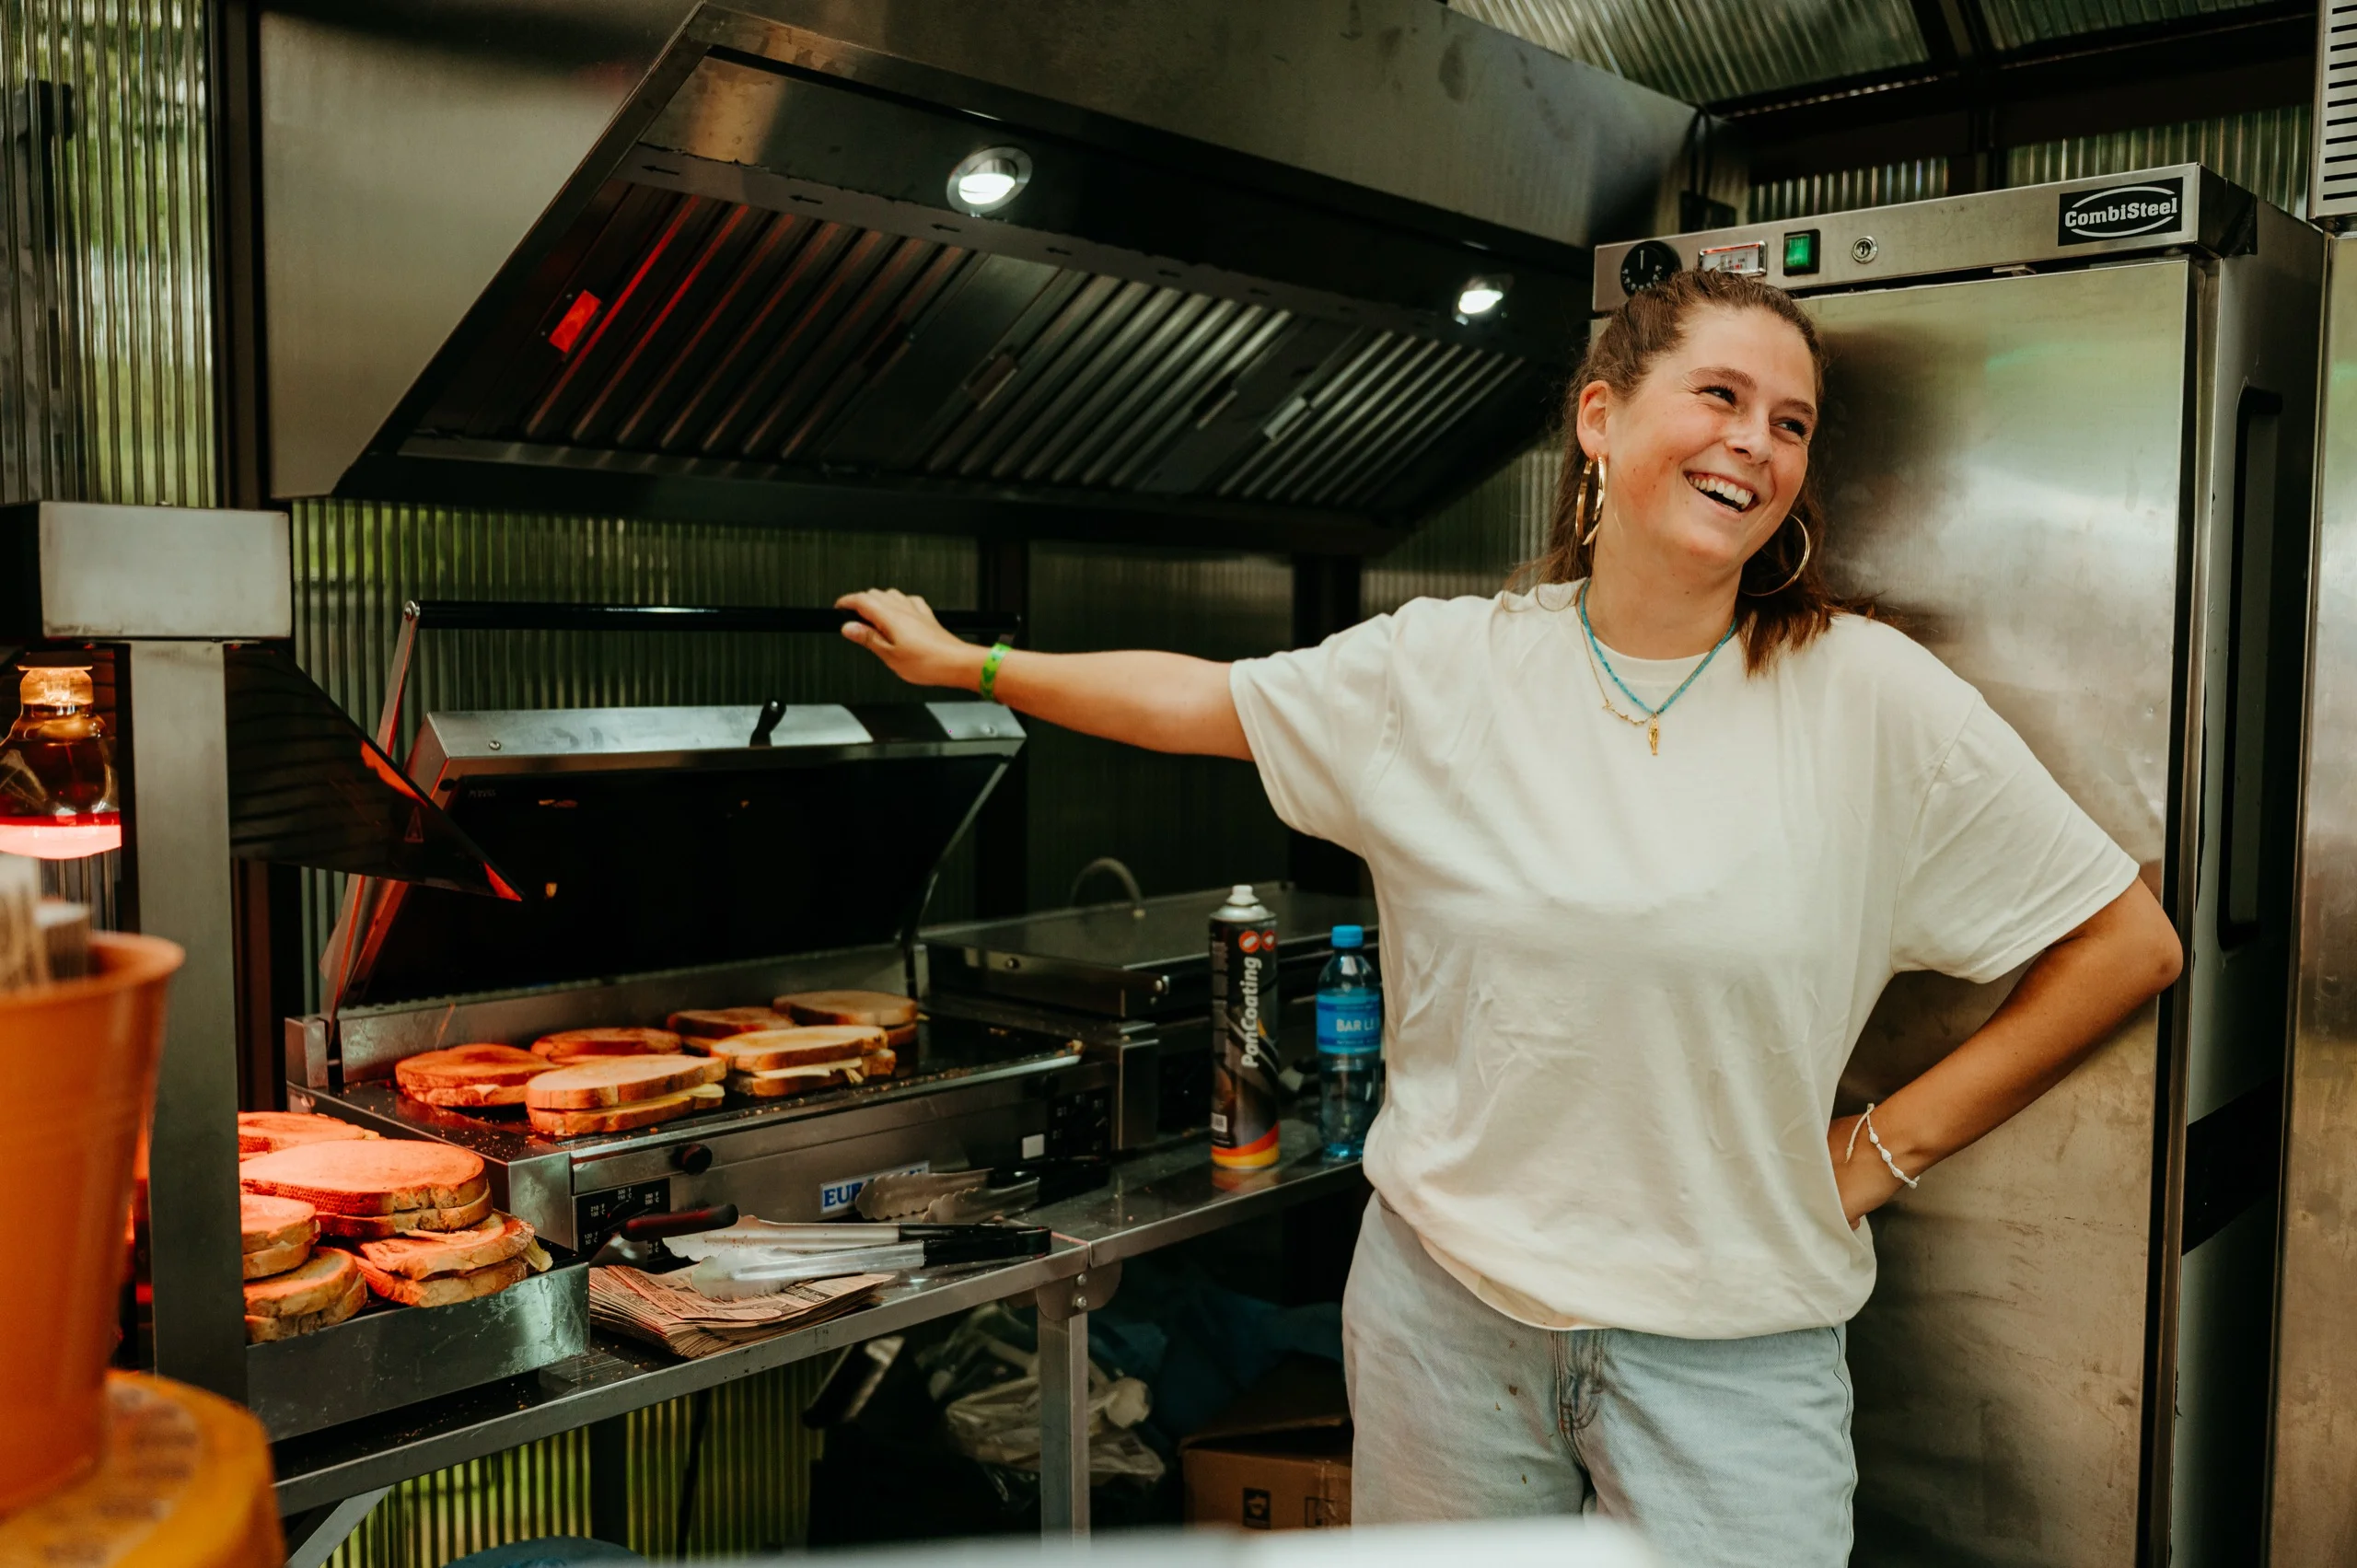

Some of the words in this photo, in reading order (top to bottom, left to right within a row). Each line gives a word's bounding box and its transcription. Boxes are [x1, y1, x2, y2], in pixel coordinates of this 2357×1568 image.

[2065, 197, 2178, 227] CombiSteel
[1239, 956, 1262, 1068] PanCoating
[1336, 1017, 1362, 1032] BAR
